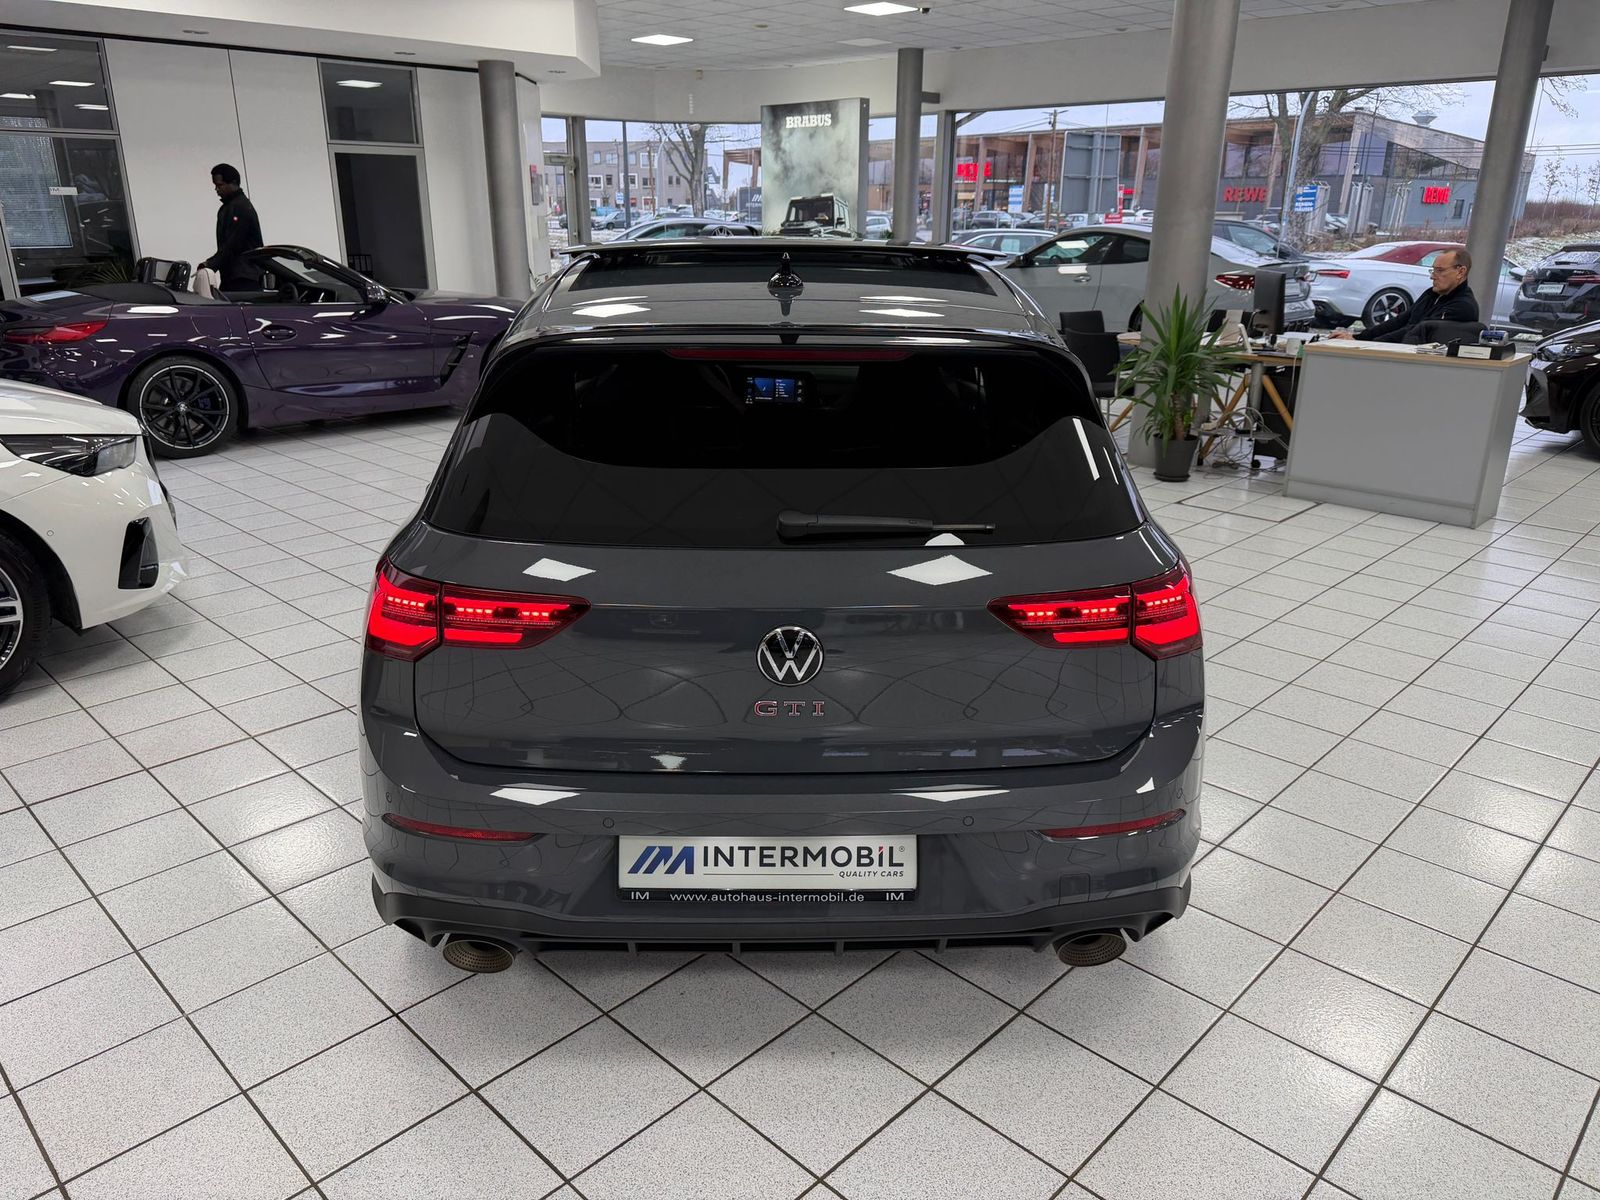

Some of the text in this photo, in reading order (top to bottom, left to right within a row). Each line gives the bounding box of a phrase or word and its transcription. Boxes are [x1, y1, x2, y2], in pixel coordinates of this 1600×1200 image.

[785, 114, 832, 129] BRABUS
[1223, 187, 1268, 203] REWE
[754, 700, 825, 717] GTI
[839, 870, 905, 879] QUALITY CARS
[631, 891, 905, 902] IM www.autohaus-intermobil.de IM
